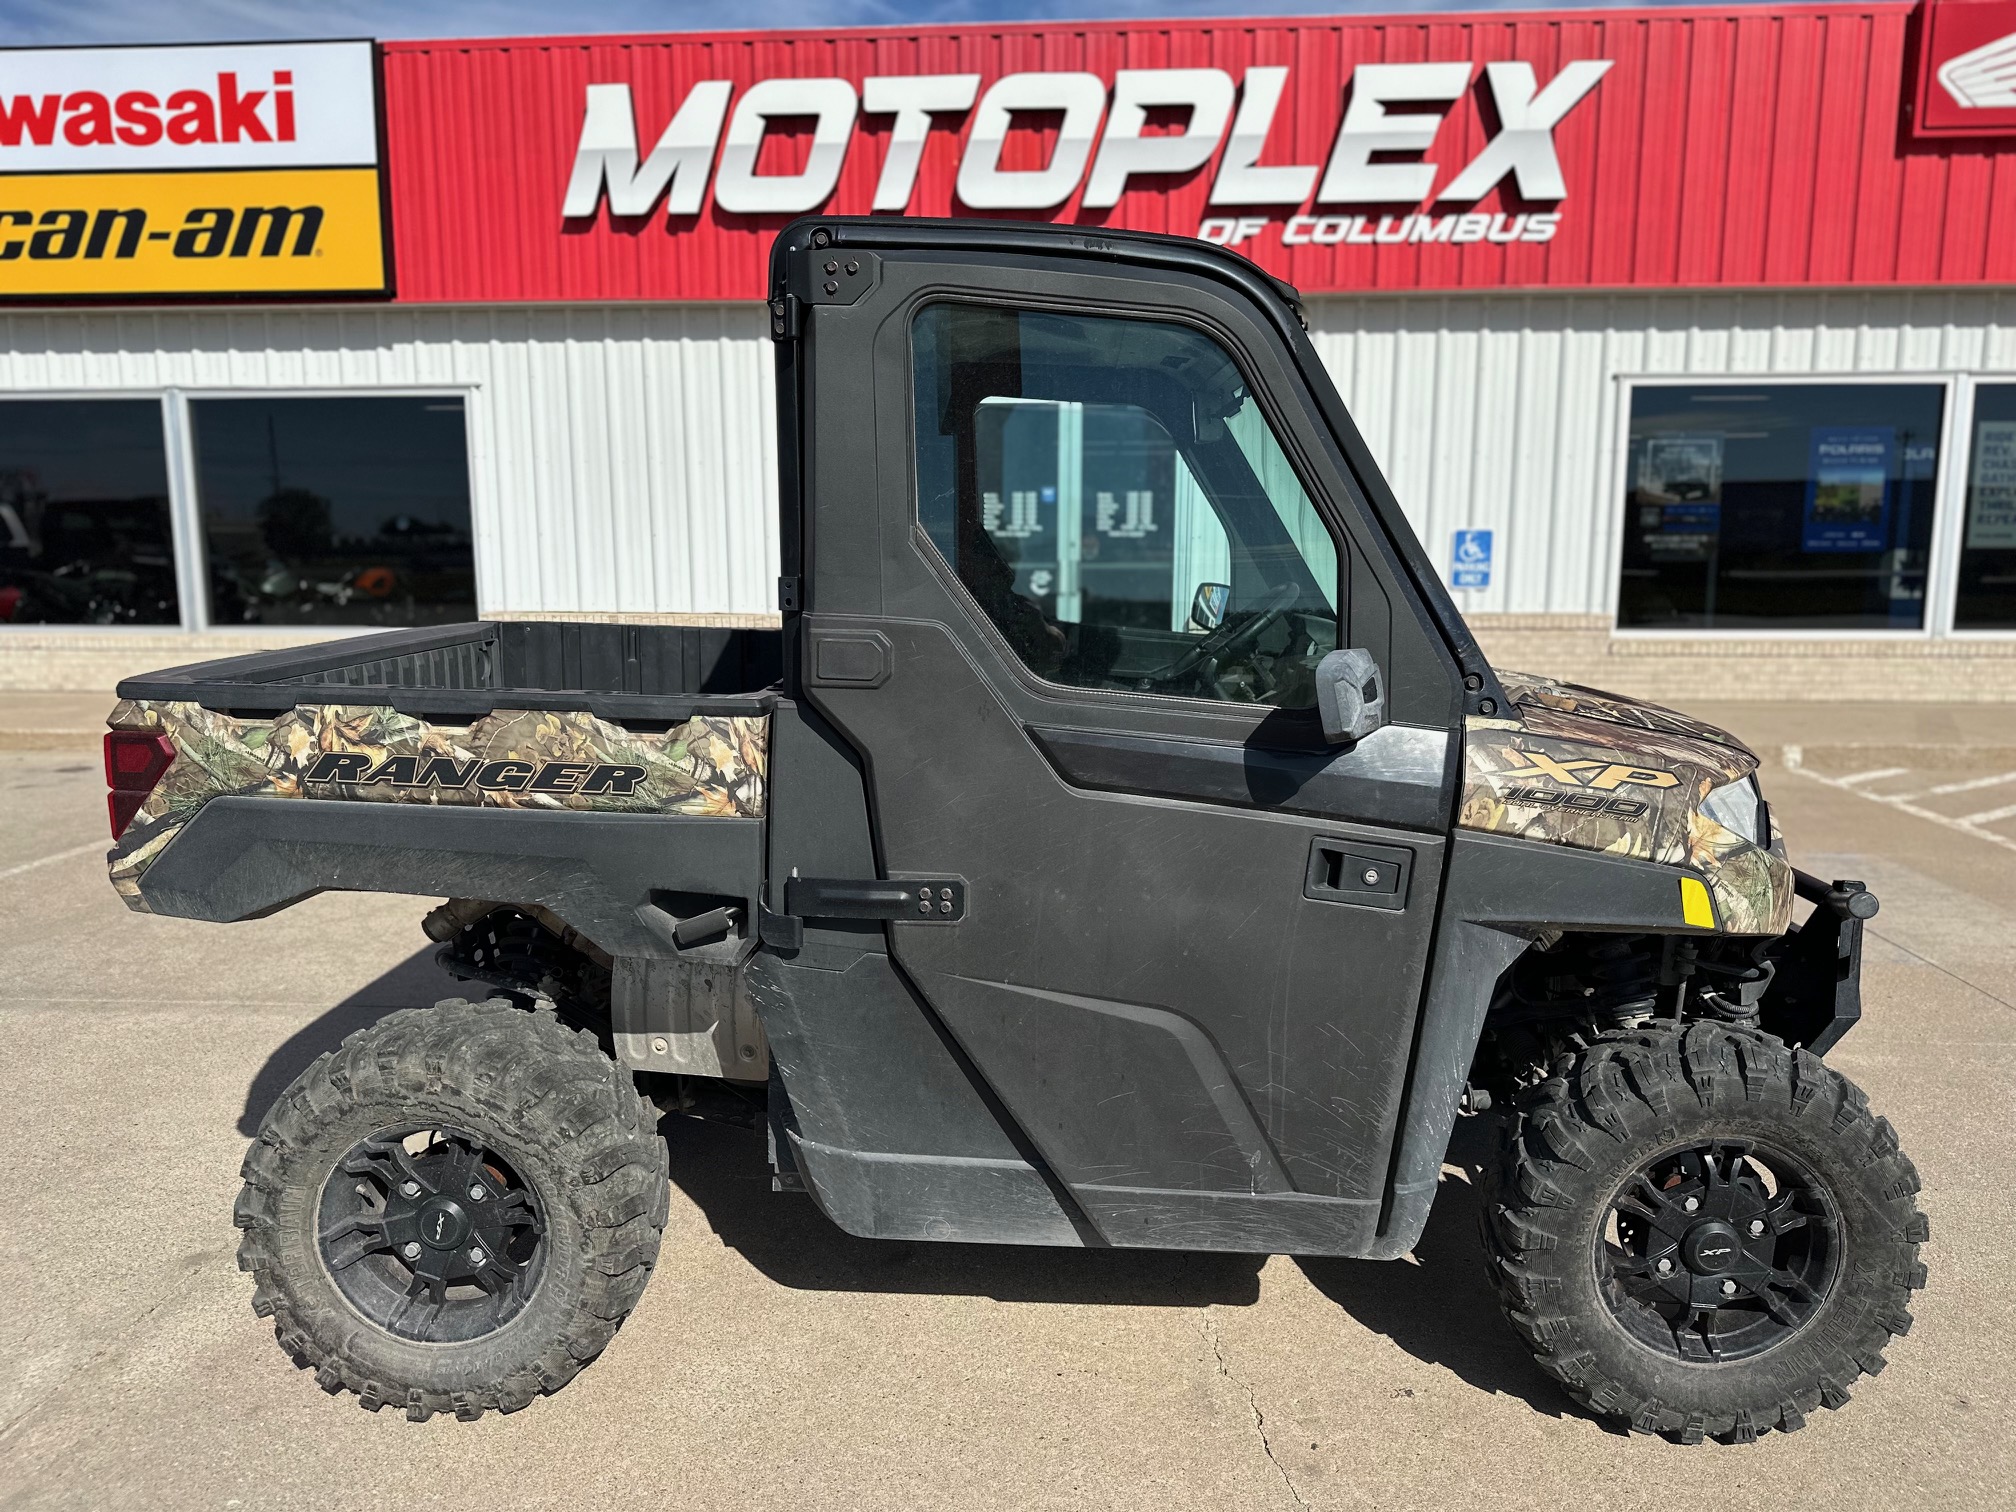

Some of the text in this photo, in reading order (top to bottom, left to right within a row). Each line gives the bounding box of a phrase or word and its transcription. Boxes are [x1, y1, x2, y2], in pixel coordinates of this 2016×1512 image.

[0, 70, 296, 146] wasaki
[561, 58, 1614, 217] MOTOPLEX
[0, 205, 324, 260] can-am
[1197, 212, 1562, 246] OF COLUMBUS
[1818, 443, 1885, 456] POLARIS
[304, 751, 648, 796] RANGER
[1490, 750, 1683, 790] XP
[1504, 785, 1649, 816] 1000
[1540, 803, 1609, 819] OVERHEAD
[1610, 813, 1639, 823] CAM
[436, 1212, 445, 1240] XP
[1699, 1248, 1731, 1257] XP
[1769, 1261, 1877, 1387] X-TERRAIN
